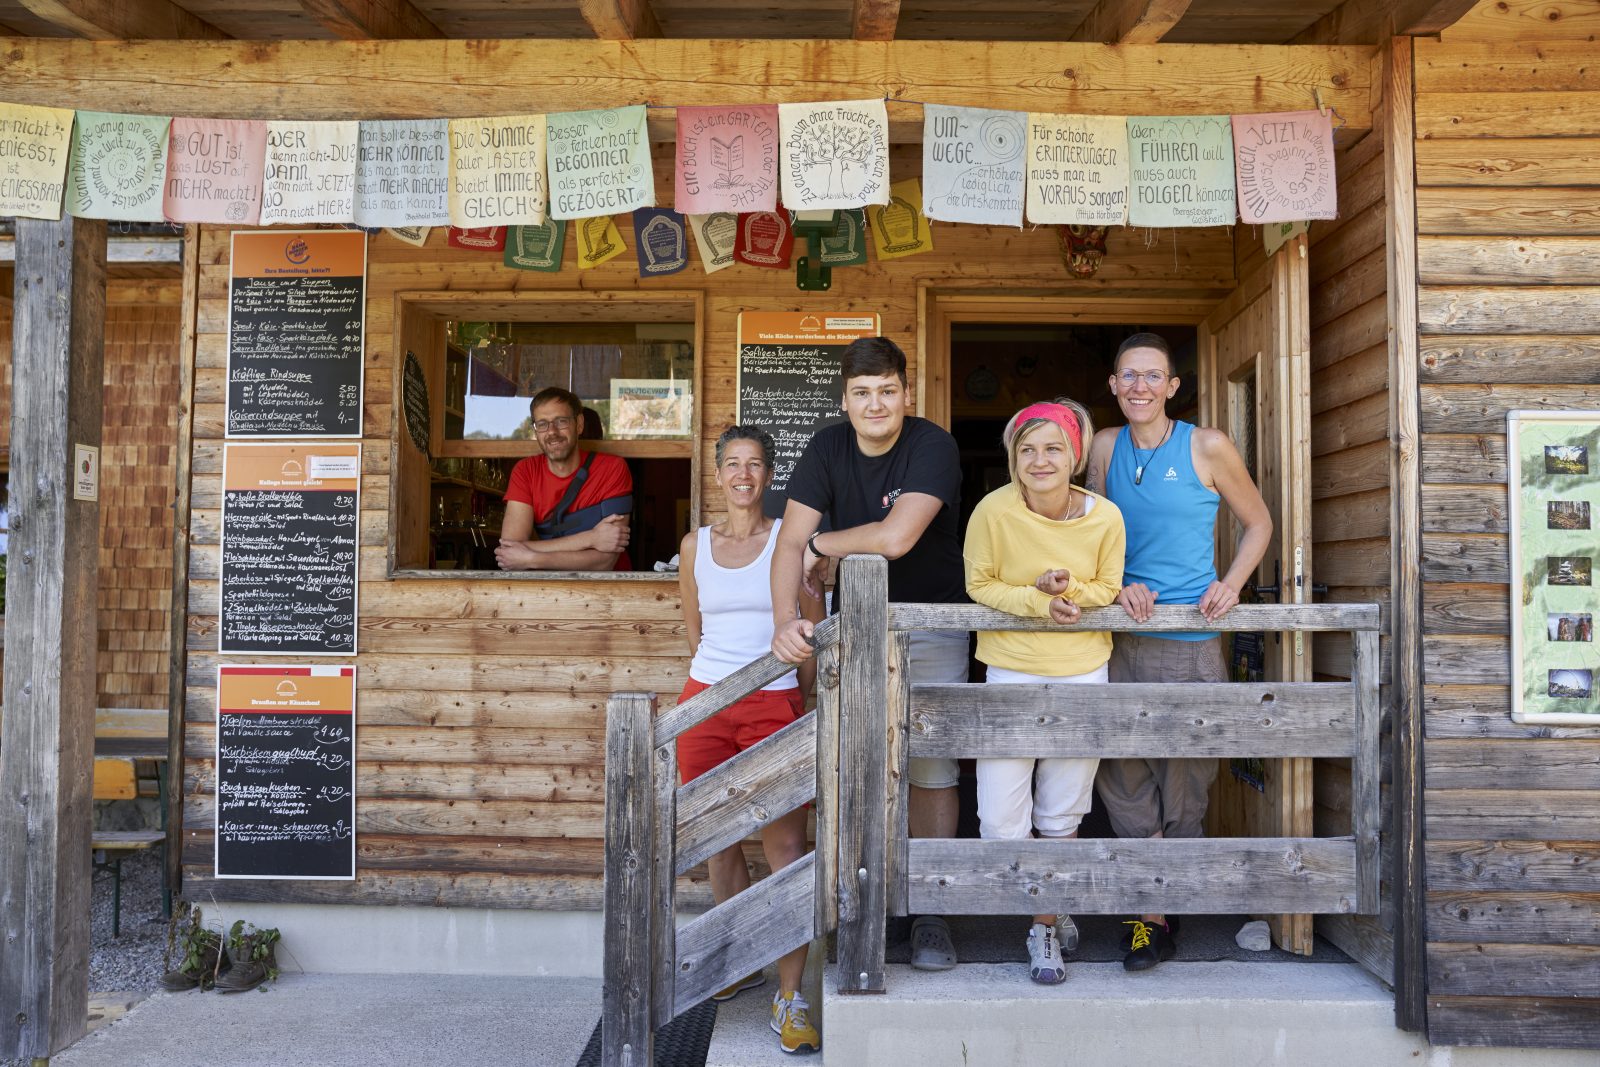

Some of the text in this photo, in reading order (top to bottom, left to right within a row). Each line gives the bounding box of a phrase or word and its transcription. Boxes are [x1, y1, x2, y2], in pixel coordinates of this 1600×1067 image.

[14, 118, 51, 136] nicht
[128, 122, 140, 134] an
[690, 117, 708, 136] ist
[708, 114, 726, 126] ein
[728, 112, 772, 141] GARTEN
[94, 121, 124, 138] genug
[381, 129, 404, 142] sollte
[409, 128, 446, 142] besser
[454, 126, 535, 149] Die SUMME
[547, 124, 588, 142] Besser
[786, 118, 810, 149] Baum
[810, 110, 834, 124] ohne
[1032, 124, 1094, 144] Für schöne
[1132, 124, 1155, 140] Wer
[127, 139, 136, 149] zu
[143, 128, 162, 160] einem
[188, 132, 242, 160] GUT ist
[268, 130, 306, 148] WER
[571, 128, 638, 153] fehlerhaft
[762, 142, 772, 154] in
[92, 149, 105, 164] die
[135, 146, 146, 162] dir
[270, 152, 296, 162] wenn
[360, 147, 392, 162] MEHR
[456, 151, 536, 170] aller LASTER
[556, 148, 630, 172] BEGONNEN
[683, 136, 696, 168] BUCH
[1036, 144, 1116, 166] ERINNERUNGEN
[1141, 140, 1225, 163] FÜHREN will
[8, 162, 20, 174] ist
[170, 160, 250, 176] was LUST auf
[358, 163, 440, 176] als man macht,
[763, 158, 776, 174] der
[1134, 166, 1197, 182] muss auch
[88, 166, 111, 199] kommt
[268, 174, 354, 192] wenn nicht JETZT?
[456, 172, 543, 192] bleibt IMMER
[558, 169, 625, 192] als perfekt
[1032, 168, 1101, 184] muss man im
[1319, 172, 1328, 184] zu
[170, 178, 256, 201] MEHR macht!
[358, 178, 448, 194] statt MEHR MACHE
[730, 176, 774, 208] TASCHE
[962, 178, 1011, 194] lediglich
[1138, 184, 1234, 204] FOLGEN können
[264, 192, 283, 208] WO
[361, 200, 378, 210] als
[382, 200, 402, 210] man
[947, 192, 1024, 210] die Ortskenntnis
[1040, 184, 1128, 210] VORAUS sorgen!
[1292, 186, 1327, 210] warten
[265, 200, 350, 218] wenn nicht HIER?
[464, 196, 526, 218] GLEICH
[301, 278, 332, 287] Suppen
[743, 346, 820, 357] Saftiges Rumpsteak
[232, 367, 312, 380] Kräftige Rindsuppe
[742, 417, 773, 426] Nudeln
[320, 786, 344, 794] 4.20
